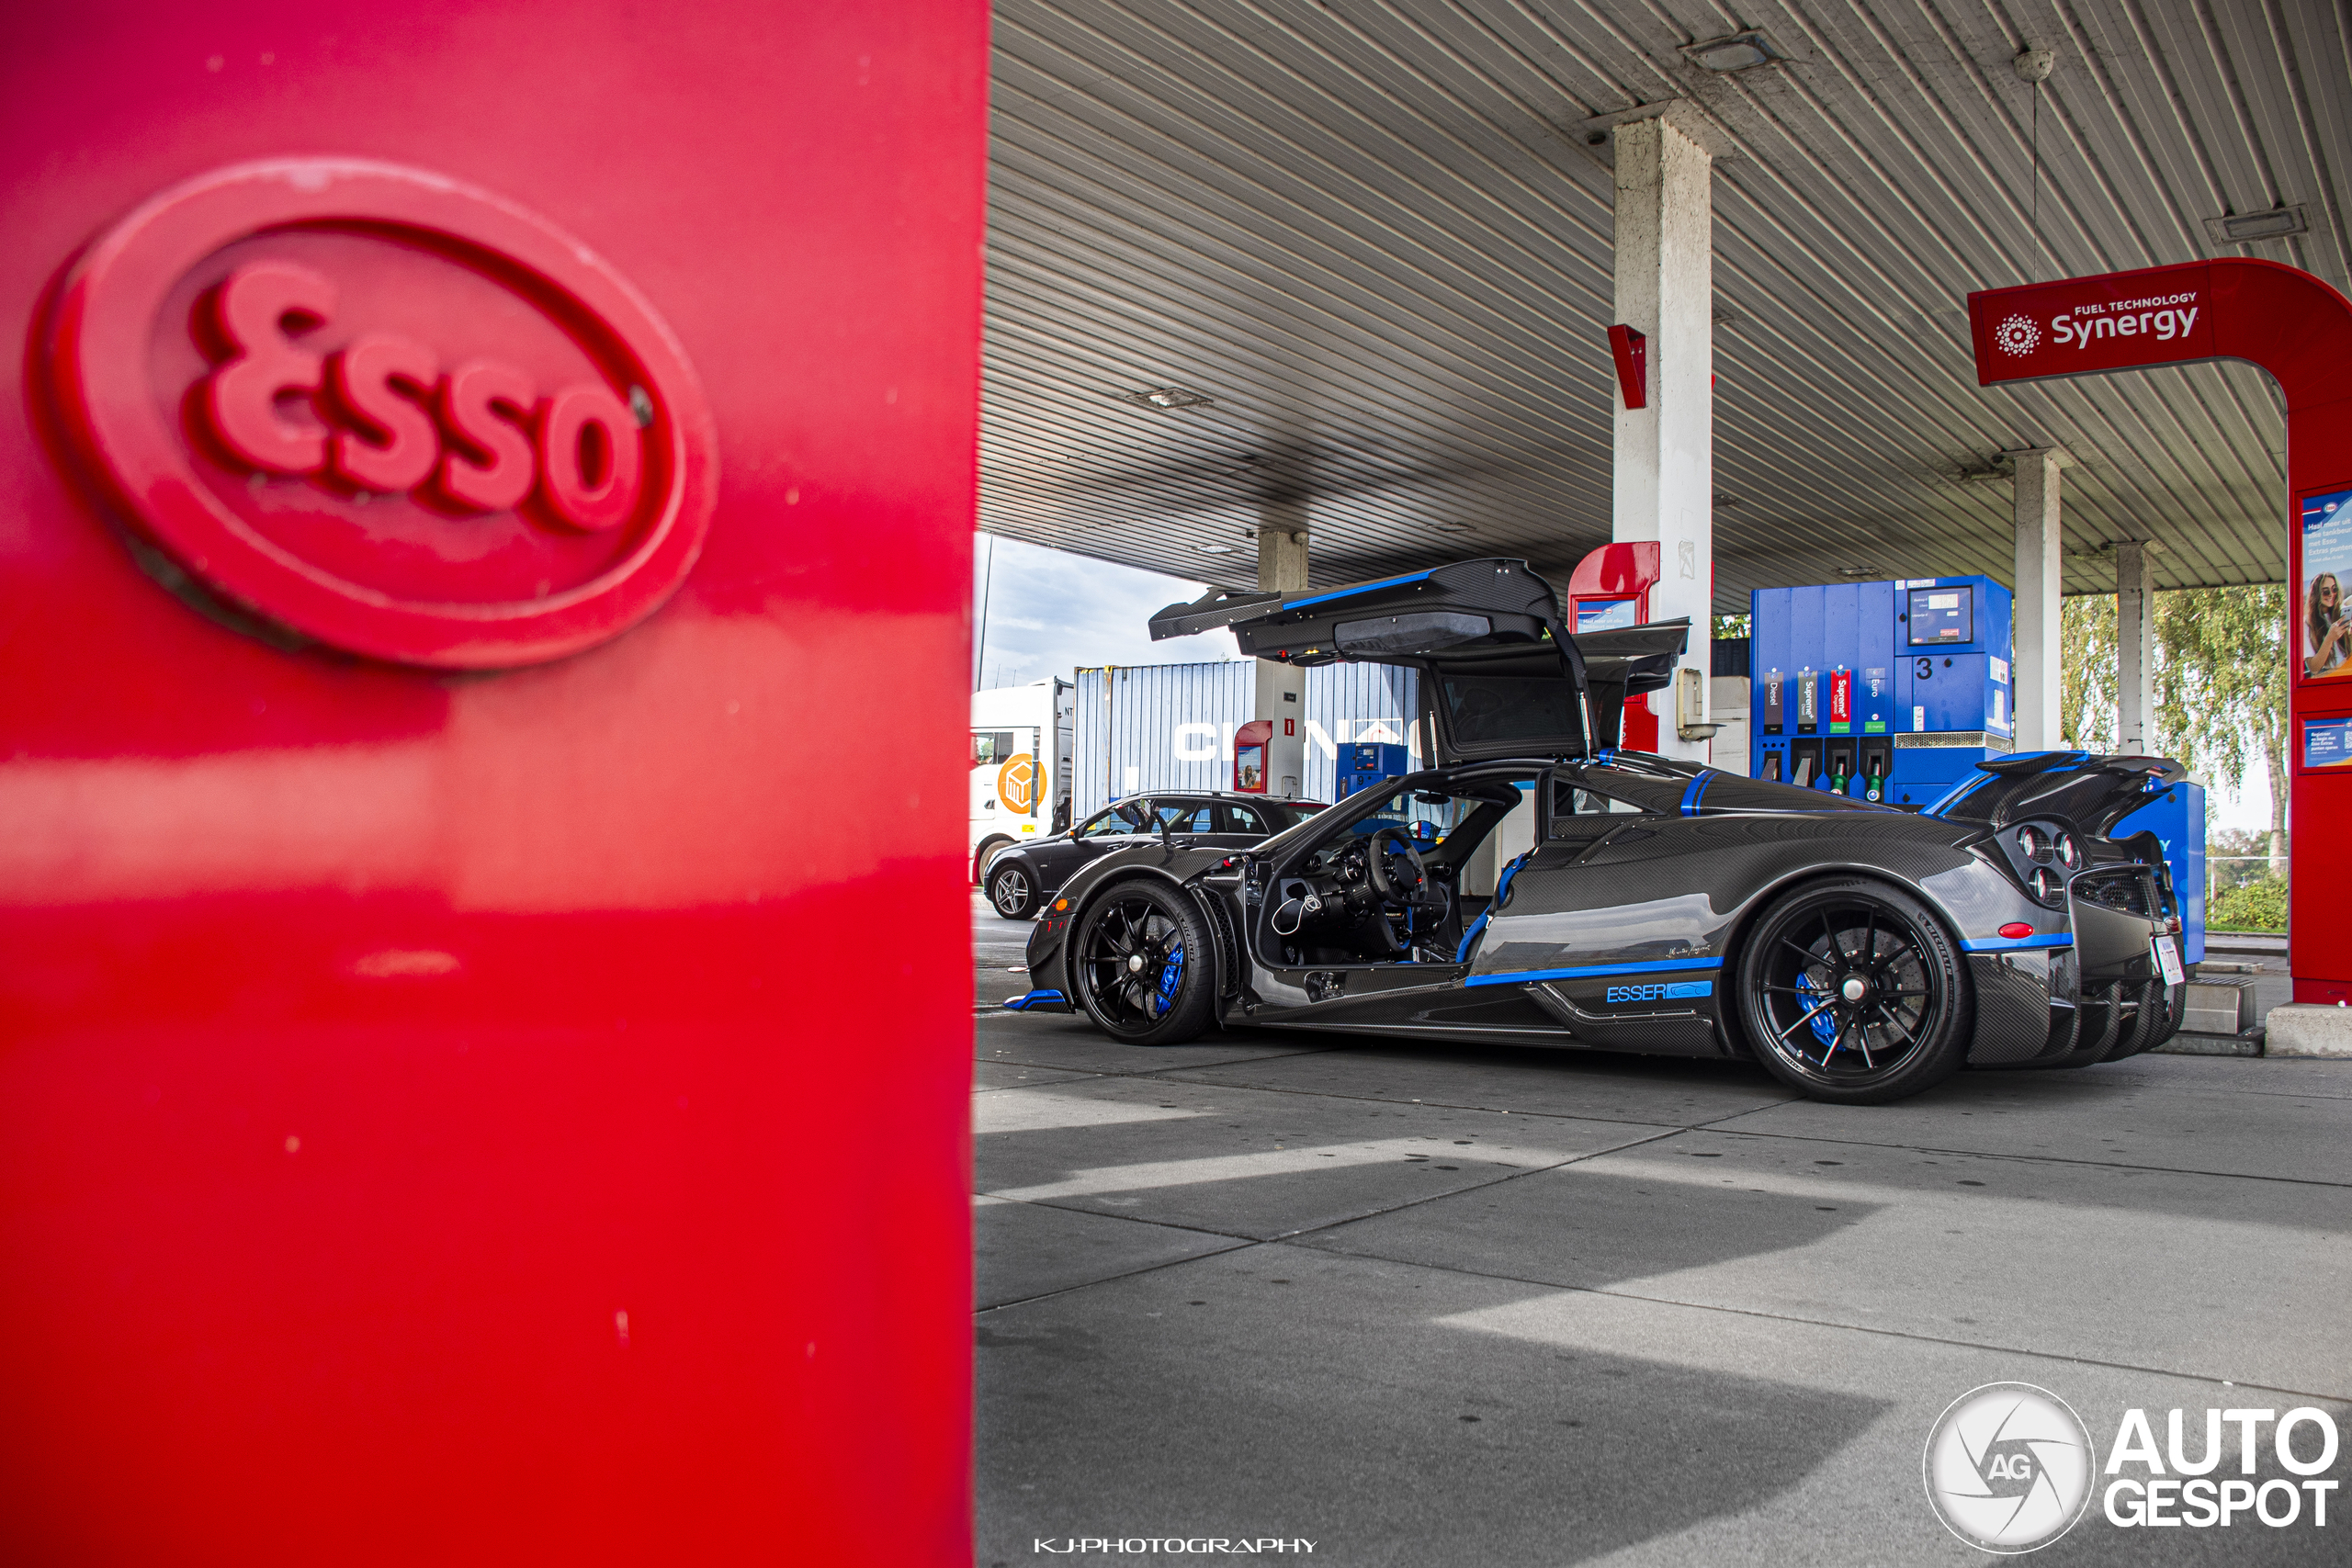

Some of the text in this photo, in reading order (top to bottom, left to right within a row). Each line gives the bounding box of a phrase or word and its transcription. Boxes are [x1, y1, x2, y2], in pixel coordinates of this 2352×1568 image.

[2075, 292, 2197, 316] FUEL TECHNOLOGY
[2052, 307, 2198, 349] Synergy
[198, 258, 640, 533] Esso
[2308, 522, 2323, 531] Haal
[1917, 658, 1933, 680] 3
[1770, 682, 1778, 705] Diesel
[1871, 679, 1881, 697] Euro
[1358, 776, 1364, 785] 9
[1926, 924, 1953, 976] MICHELIN
[1607, 983, 1667, 1003] ESSER
